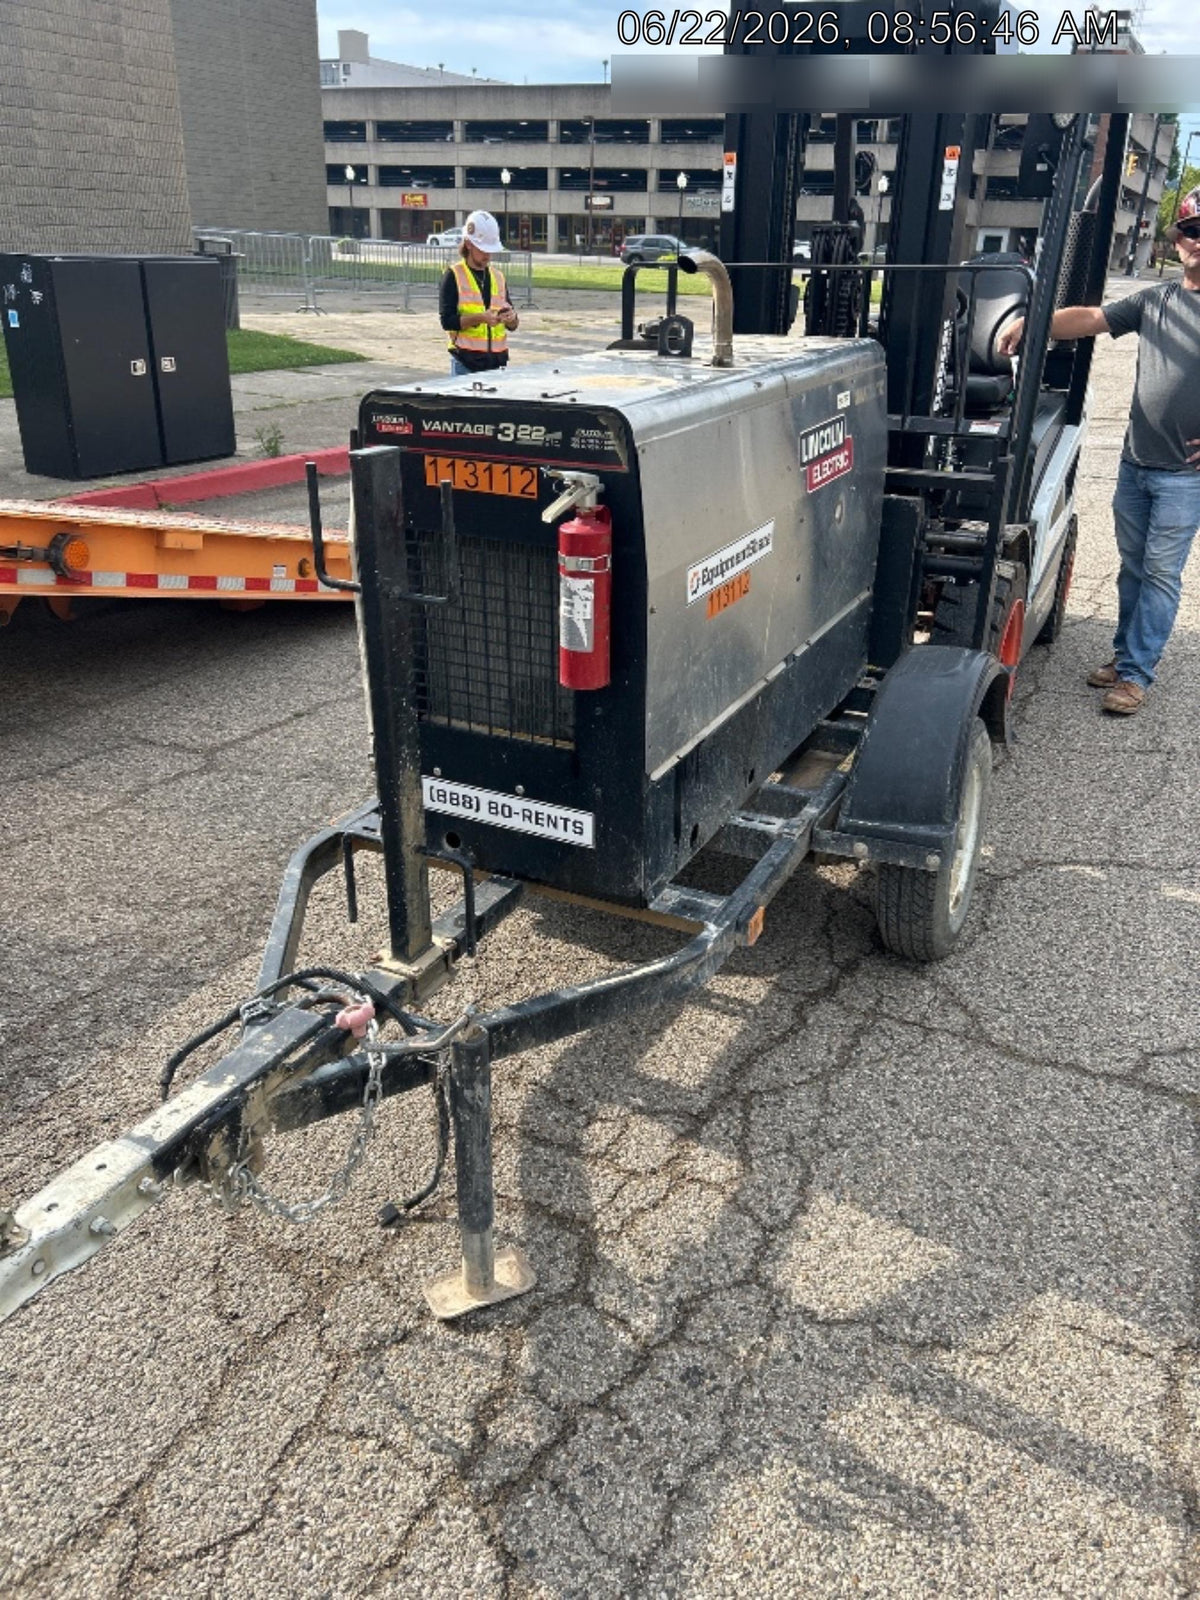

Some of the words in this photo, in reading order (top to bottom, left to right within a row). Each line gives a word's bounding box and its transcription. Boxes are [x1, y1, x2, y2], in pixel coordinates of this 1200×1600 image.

[421, 419, 493, 437] VANTAGE
[801, 420, 844, 463] LINCOLN
[428, 457, 536, 497] 113112
[812, 451, 849, 484] ELECTRIC
[429, 785, 481, 813] (888)
[488, 800, 585, 836] 80-RENTS
